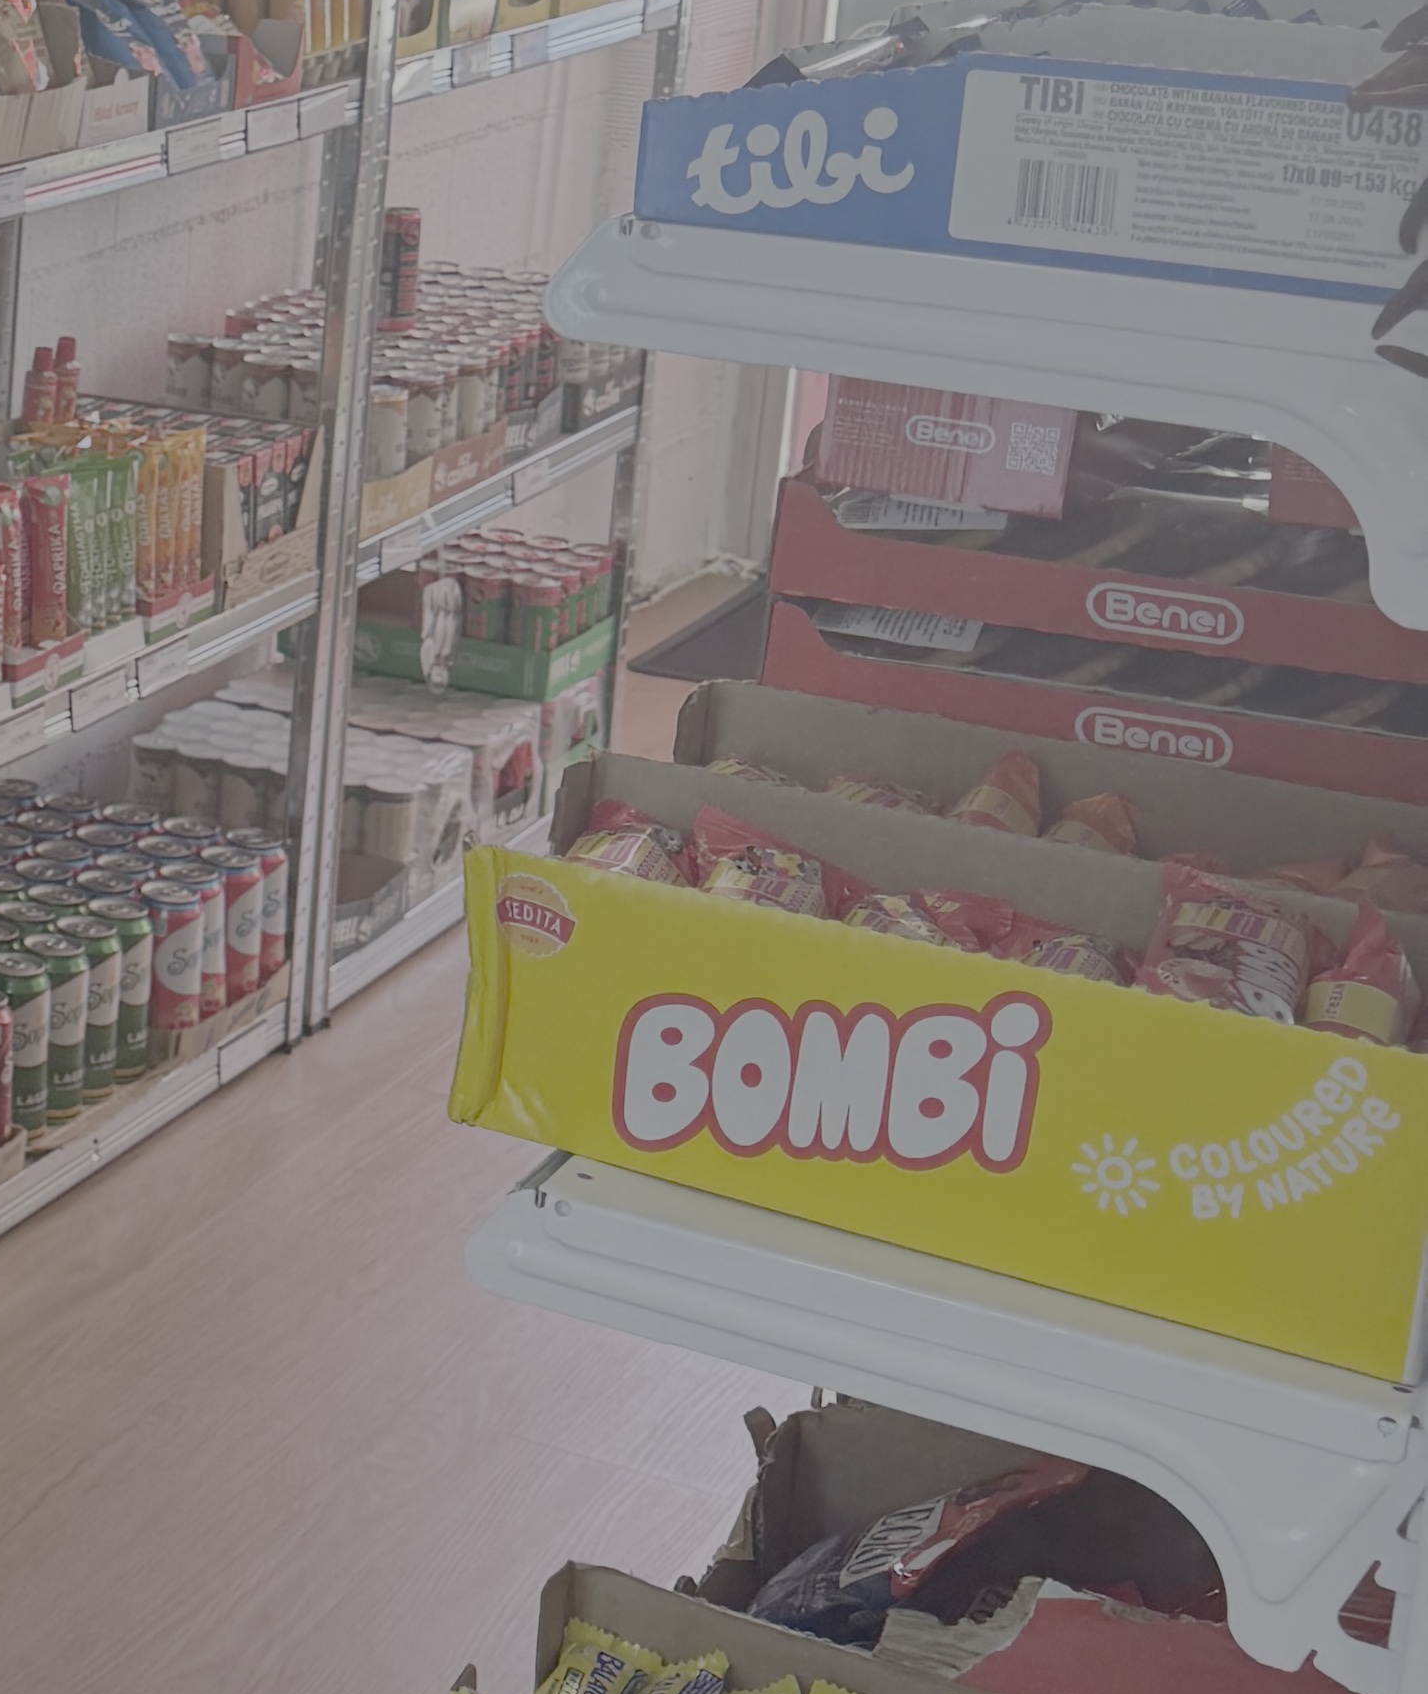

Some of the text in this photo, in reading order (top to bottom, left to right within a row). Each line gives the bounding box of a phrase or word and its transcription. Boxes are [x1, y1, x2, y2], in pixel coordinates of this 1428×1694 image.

[1020, 76, 1085, 115] TIBI
[1345, 109, 1423, 148] 0438
[685, 107, 916, 215] tibi
[1389, 175, 1419, 202] kg
[1191, 1183, 1243, 1220] BY
